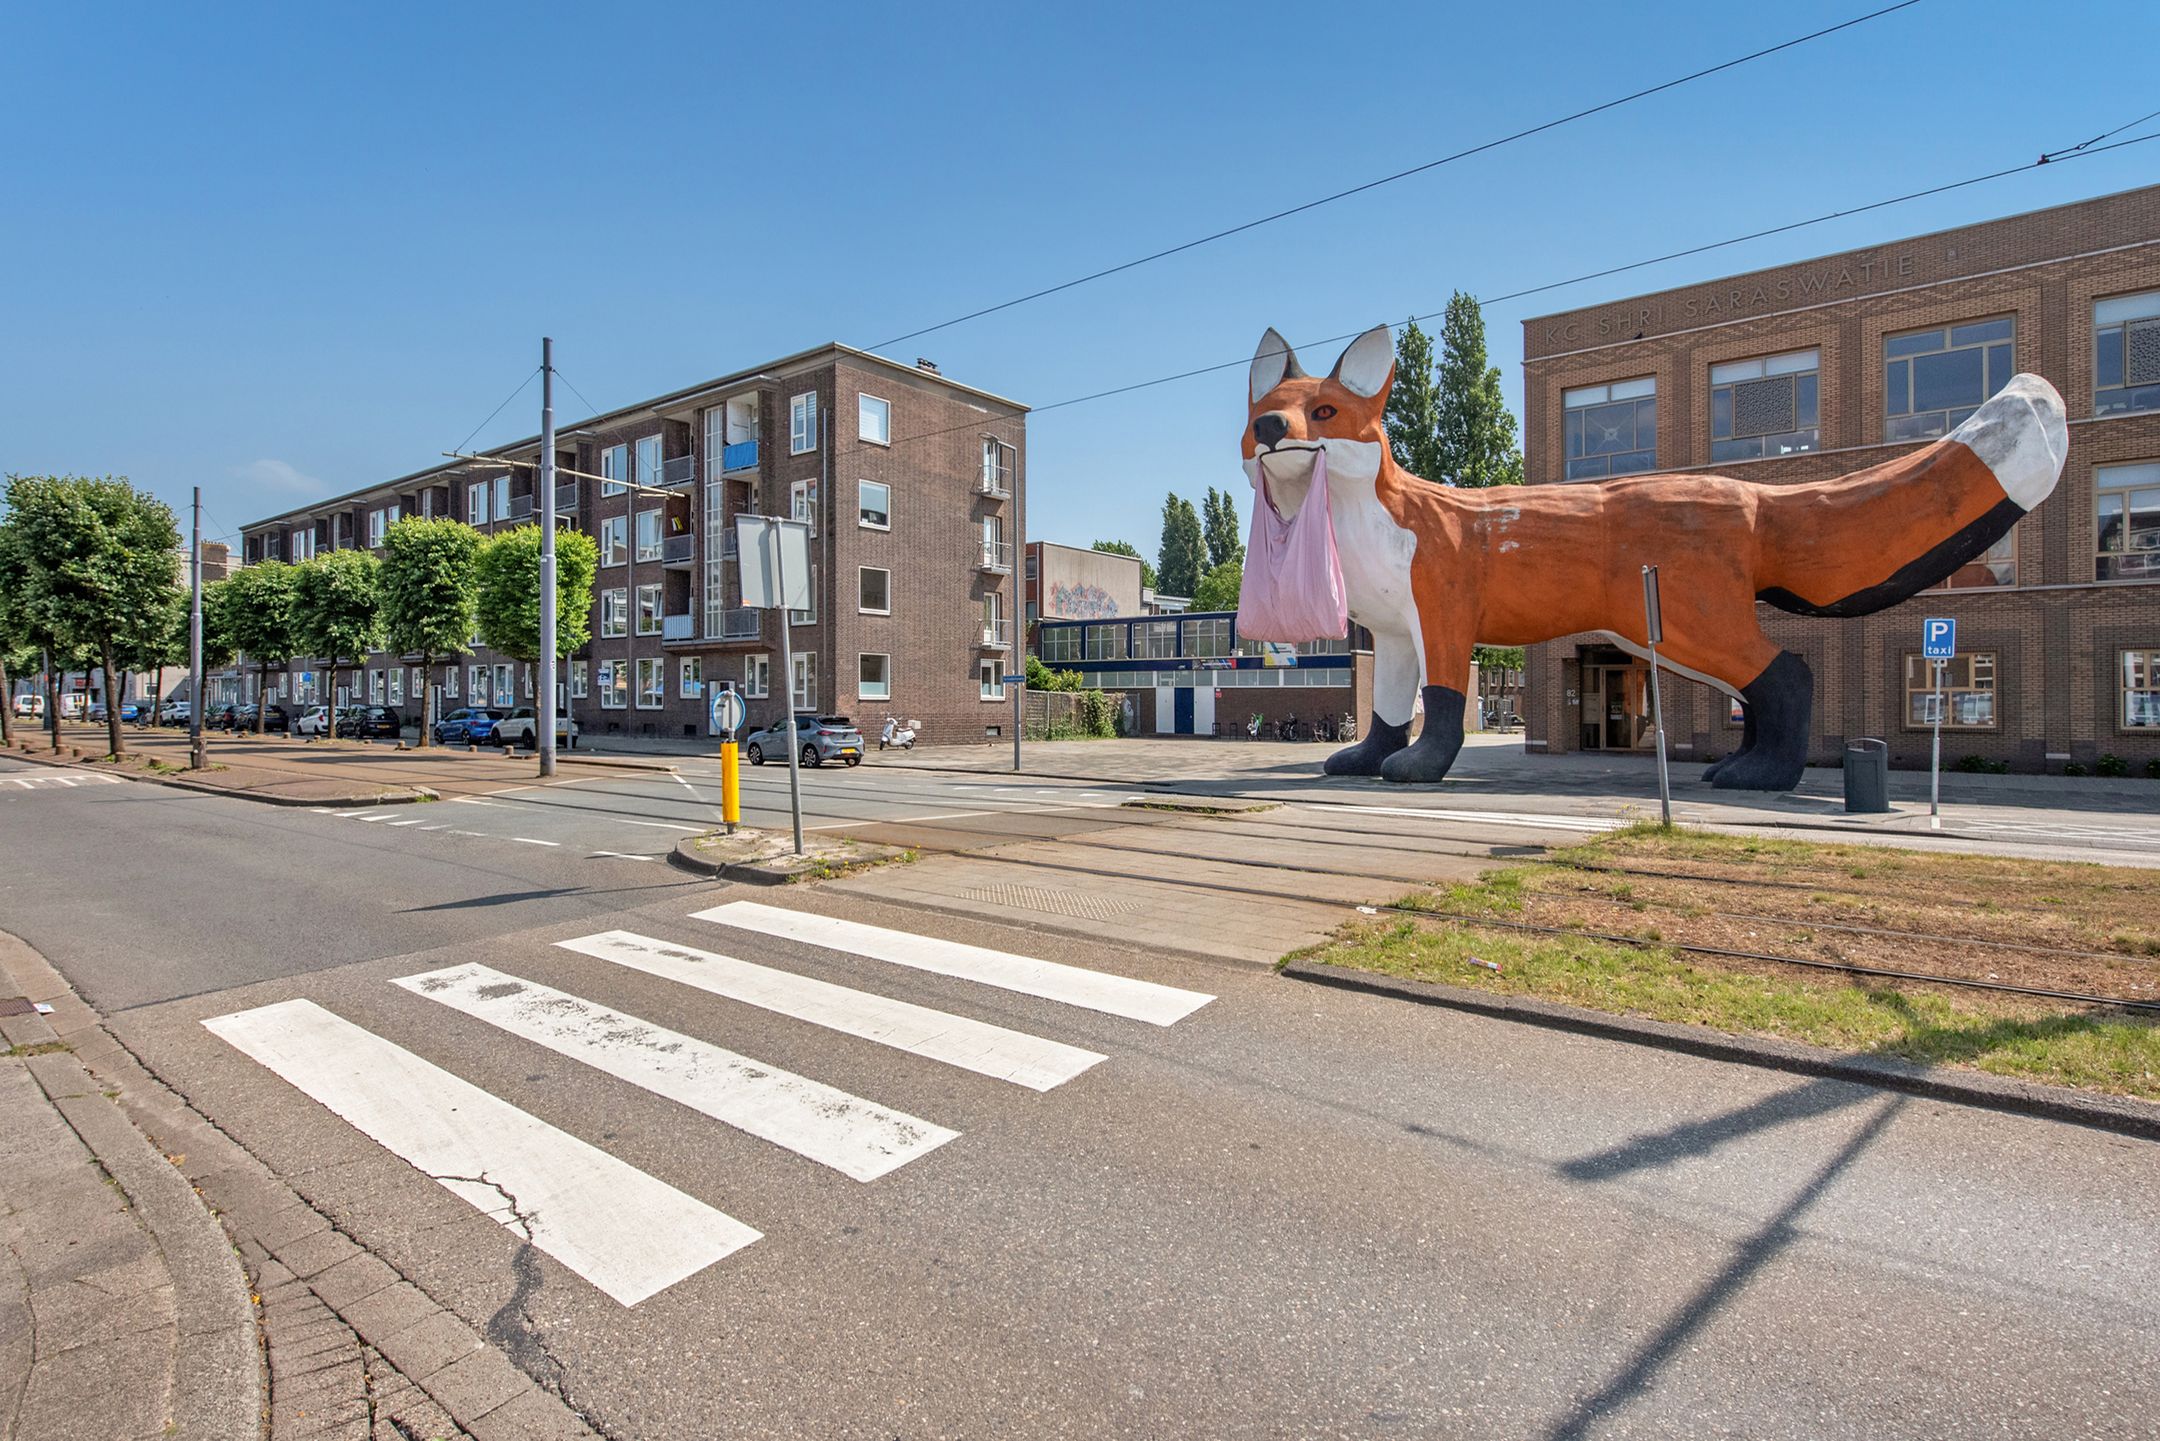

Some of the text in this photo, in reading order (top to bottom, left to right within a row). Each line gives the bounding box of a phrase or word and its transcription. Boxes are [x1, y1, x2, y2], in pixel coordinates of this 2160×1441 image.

[1545, 255, 1915, 345] KC SHRI SARASWATIE
[1931, 622, 1949, 642] P
[1927, 646, 1952, 655] taxi
